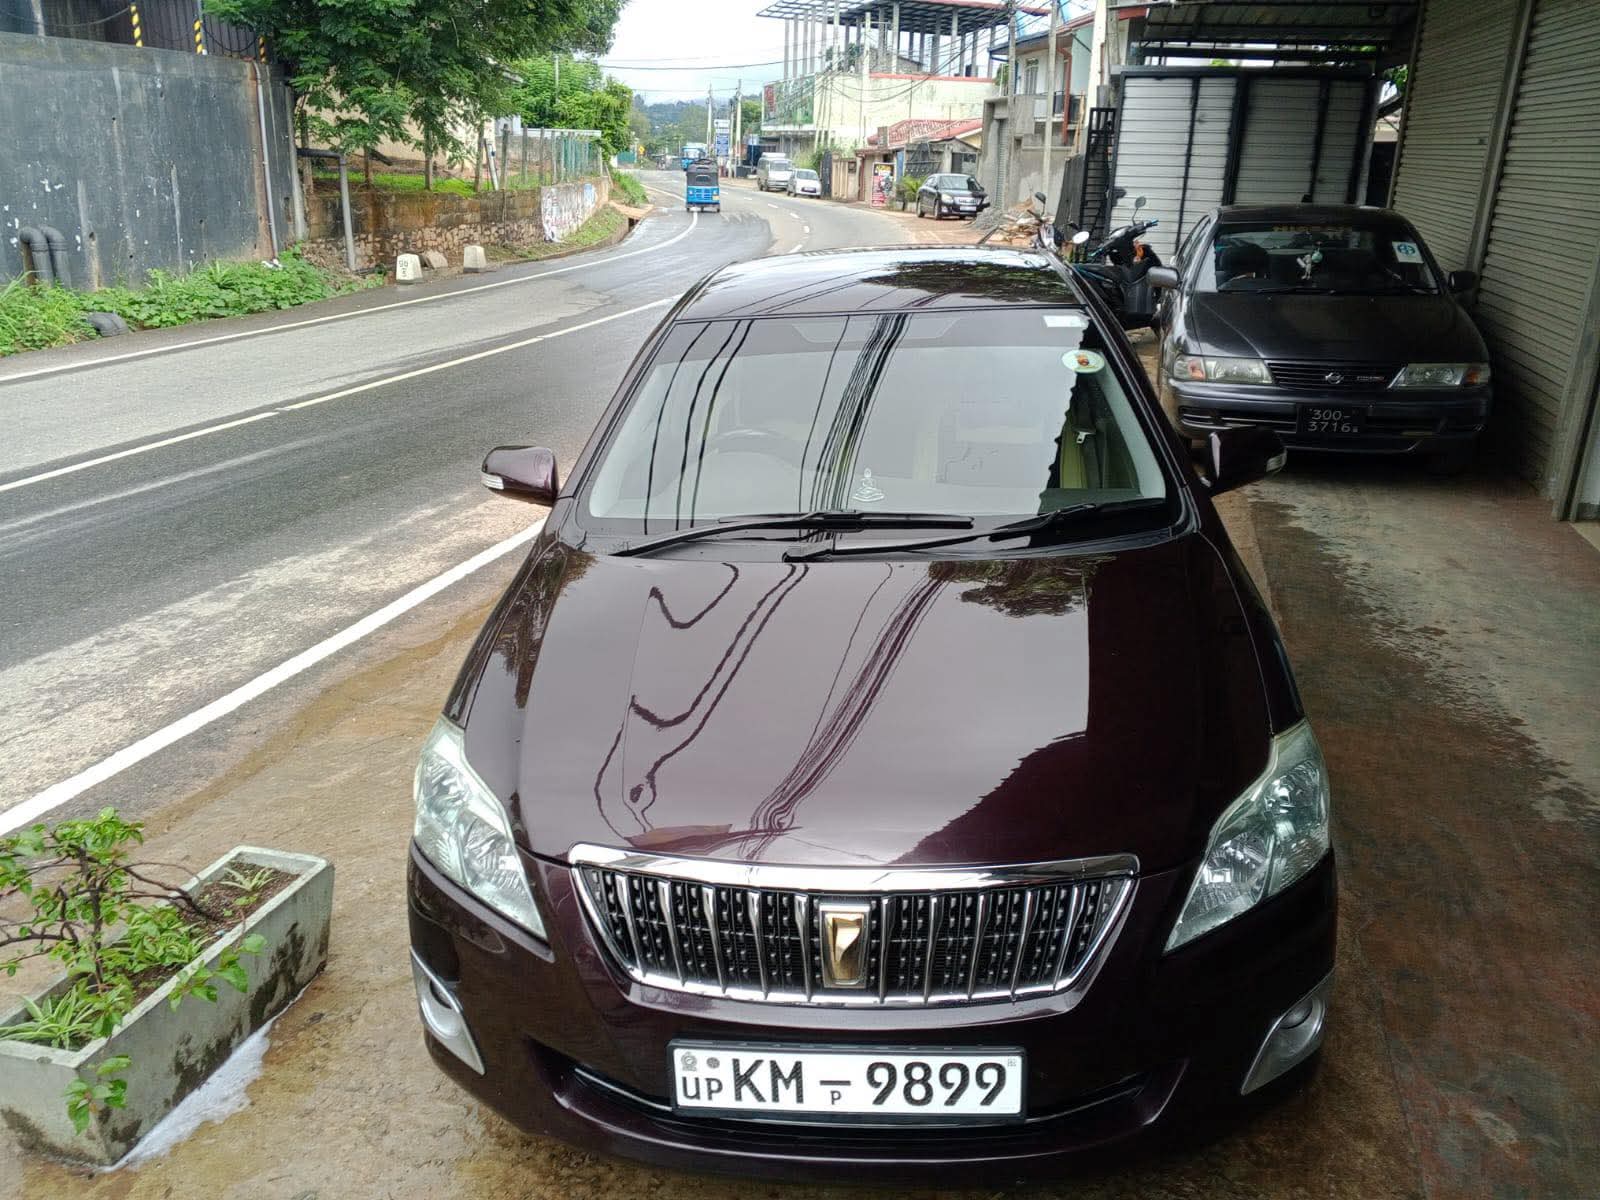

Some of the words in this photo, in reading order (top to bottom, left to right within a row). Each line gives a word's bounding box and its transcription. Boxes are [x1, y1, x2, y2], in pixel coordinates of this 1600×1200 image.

[1307, 421, 1351, 433] 3716
[681, 1076, 723, 1101] UP
[865, 1061, 1007, 1106] 9899
